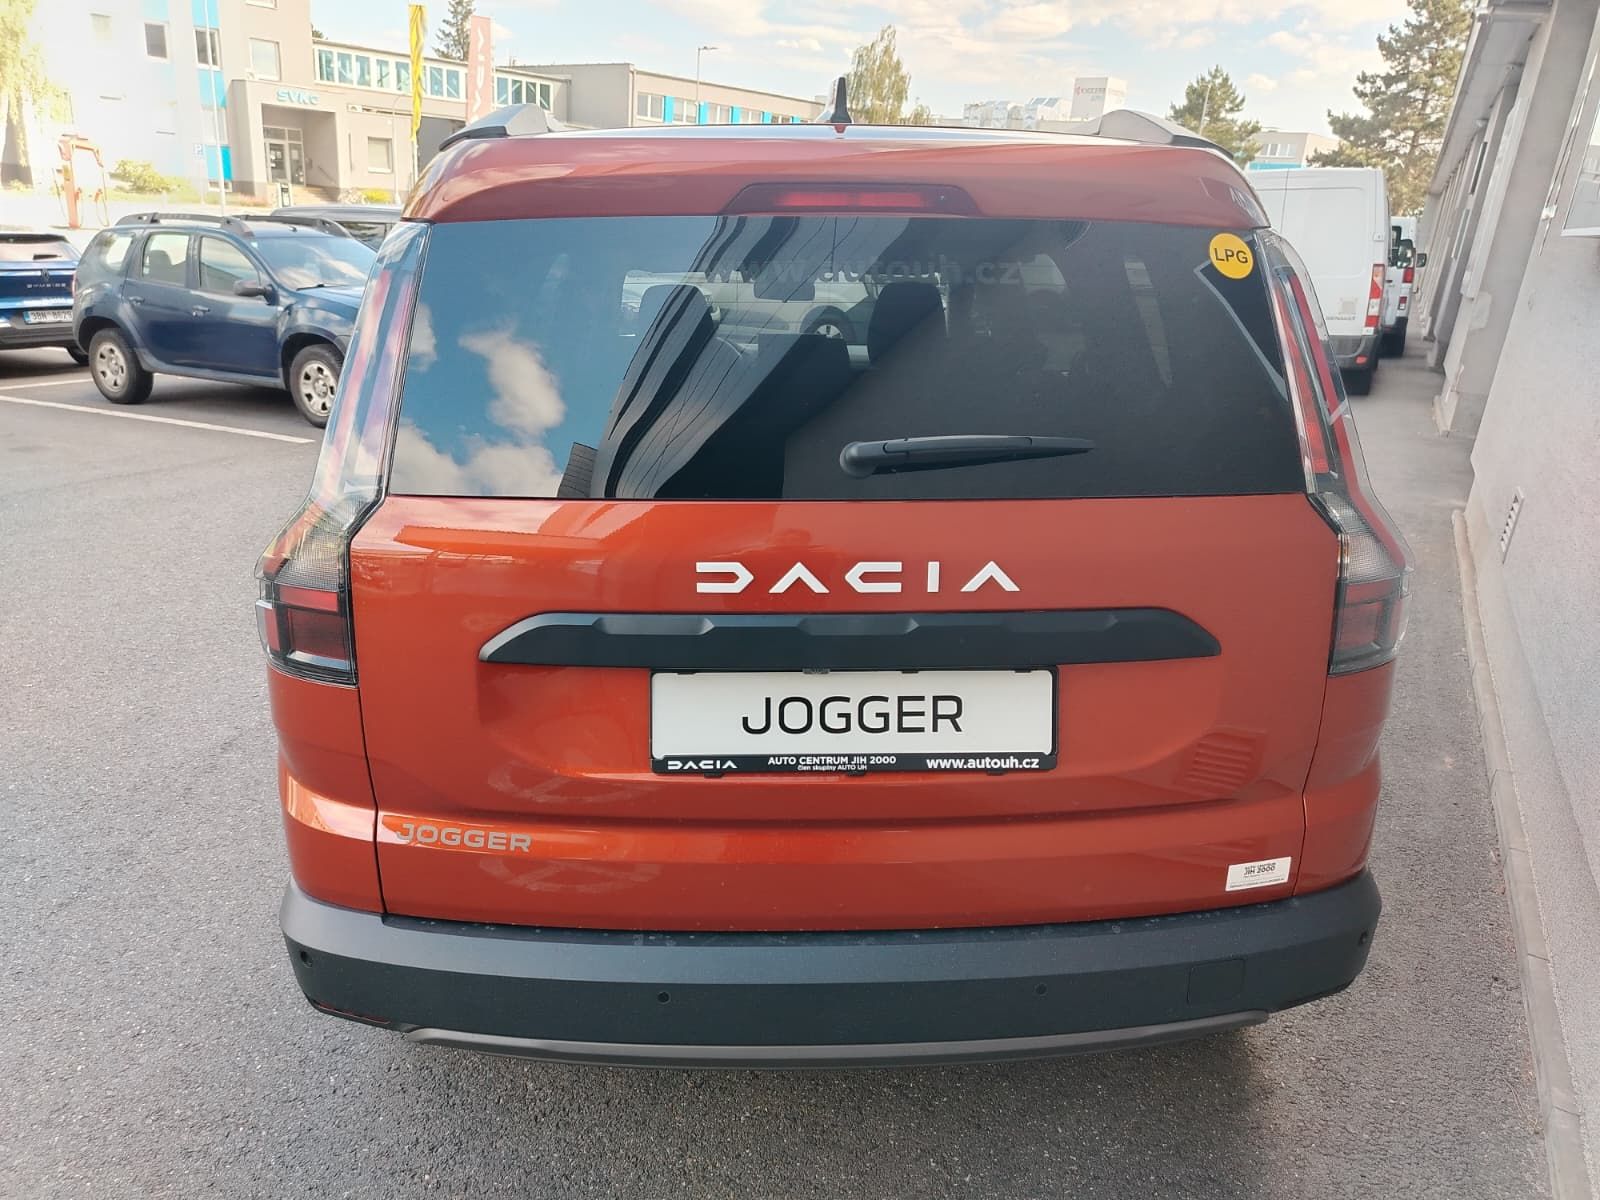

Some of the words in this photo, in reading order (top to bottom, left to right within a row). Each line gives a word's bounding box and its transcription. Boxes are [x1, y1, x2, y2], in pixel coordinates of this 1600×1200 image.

[1213, 247, 1249, 264] LPG
[695, 560, 1021, 594] DACIA
[742, 694, 964, 735] JOGGER
[667, 760, 738, 770] DACIA
[767, 756, 797, 766] AUTO
[799, 756, 849, 765] CENTRUM
[850, 756, 867, 764] JIH
[869, 755, 897, 764] 2000
[926, 756, 1040, 769] www.autouh.cz
[396, 823, 532, 853] JOGGER
